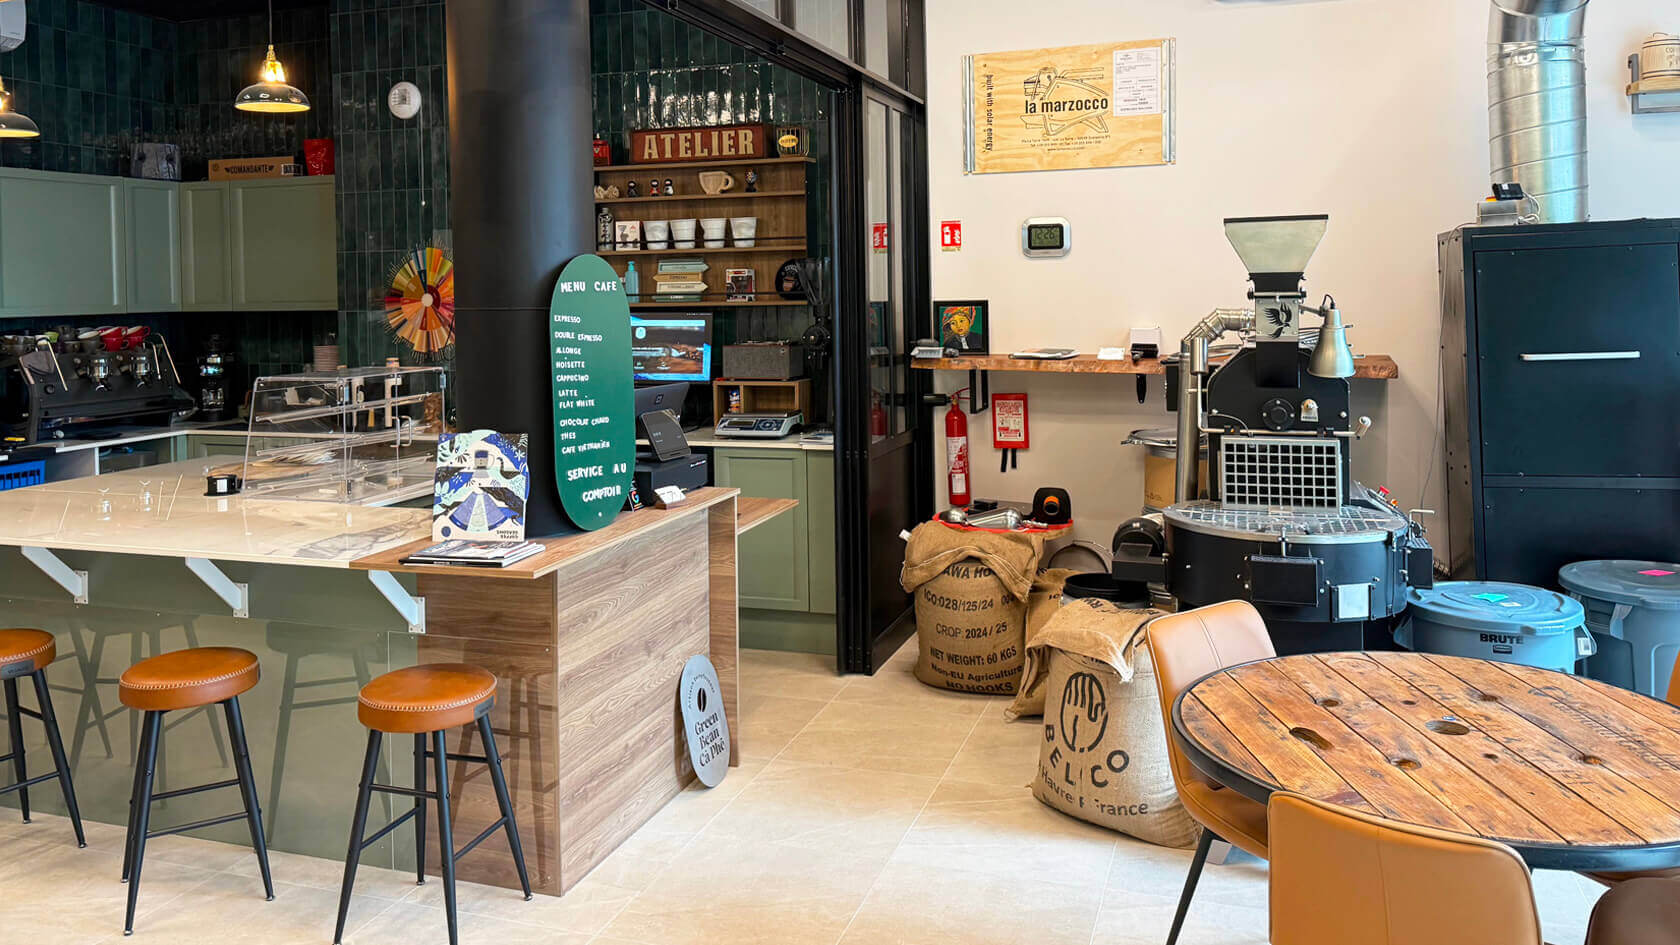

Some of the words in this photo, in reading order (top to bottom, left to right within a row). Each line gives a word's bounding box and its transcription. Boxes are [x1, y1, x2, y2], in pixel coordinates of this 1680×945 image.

[986, 74, 994, 90] built
[986, 92, 994, 107] with
[1025, 100, 1036, 114] la
[1041, 98, 1108, 113] marzocco
[986, 109, 994, 126] solar
[643, 130, 754, 160] ATELIER
[985, 128, 993, 151] energy
[230, 164, 268, 174] COMANDANTE
[560, 281, 586, 293] MENU
[594, 281, 617, 292] CAFE
[554, 315, 581, 323] EXPRESSO
[554, 331, 575, 339] DOUBLE
[577, 334, 602, 342] ESPRESSO
[556, 361, 585, 369] NOISETTE
[558, 389, 578, 397] LATTE
[576, 399, 595, 408] WHITE
[560, 418, 589, 427] CHOCOLAT
[591, 416, 610, 426] CHAUD
[561, 432, 576, 440] THES
[562, 446, 576, 454] CAFE
[567, 466, 604, 481] SERVICE
[613, 463, 627, 474] AU
[582, 485, 622, 502] COMPTOIR
[965, 627, 988, 639] 2024
[995, 621, 1007, 634] 25
[1479, 633, 1524, 644] BRUTE
[930, 647, 944, 662] NET
[946, 652, 985, 666] WEIGHT:
[987, 653, 998, 665] 60
[1000, 645, 1017, 661] KGS
[931, 663, 965, 680] Non-EU
[967, 665, 1024, 683] Agriculture
[966, 681, 1014, 693] HOOKS
[694, 712, 719, 736] Green
[699, 728, 720, 750] Bean
[1042, 766, 1075, 804] Havre
